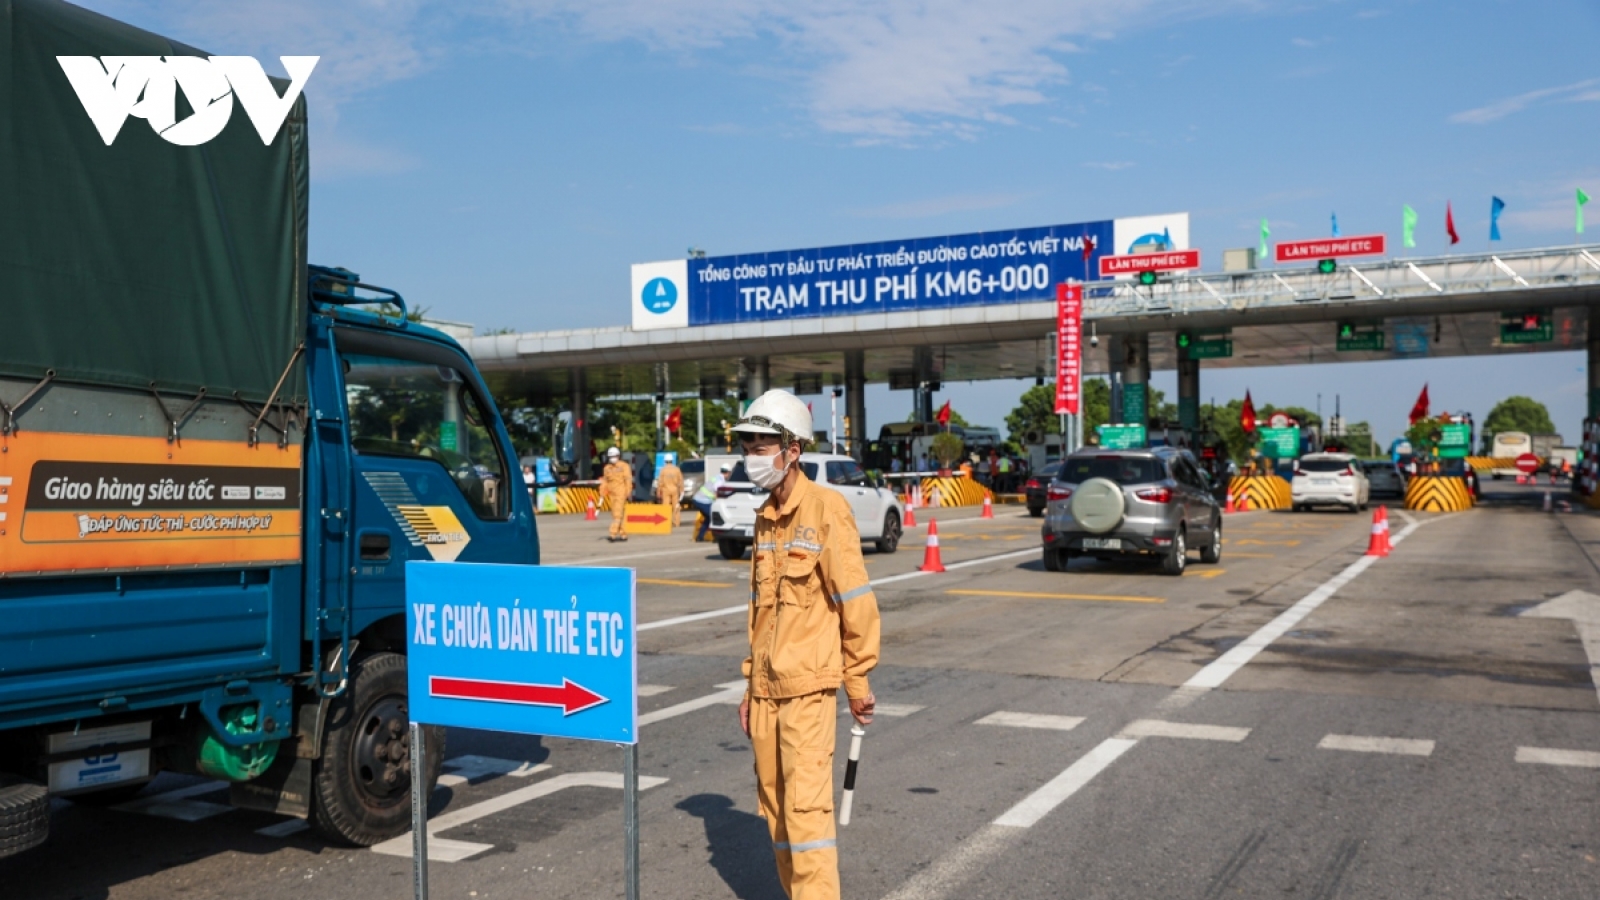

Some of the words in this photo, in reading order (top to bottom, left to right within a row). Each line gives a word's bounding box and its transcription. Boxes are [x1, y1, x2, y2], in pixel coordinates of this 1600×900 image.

[698, 263, 731, 283] TỔNG
[733, 264, 767, 281] CÔNG
[769, 263, 785, 277] TY
[787, 256, 814, 276] ĐẦU
[816, 258, 834, 273] TƯ
[837, 252, 873, 272] PHÁT
[875, 246, 915, 268] TRIỂN
[917, 243, 968, 265] ĐƯỜNG
[1027, 235, 1061, 257] VIỆT
[1108, 256, 1130, 270] LÀN
[1131, 257, 1150, 268] THU
[1151, 253, 1168, 267] PHÍ
[1168, 254, 1188, 265] ETC
[1284, 244, 1308, 257] LÀN
[1309, 243, 1330, 254] THU
[1331, 240, 1349, 253] PHÍ
[1350, 240, 1372, 252] ETC
[740, 283, 809, 314] TRẠM
[815, 279, 867, 307] THU
[875, 266, 918, 302] PHÍ
[924, 263, 1050, 299] KM6+000
[44, 476, 93, 500] Giao
[96, 476, 145, 506] hàng
[147, 478, 185, 500] siêu
[187, 477, 215, 501] tốc
[89, 515, 113, 532] ĐÁP
[114, 515, 140, 532] ỨNG
[142, 514, 165, 531] TỨC
[165, 514, 185, 531] THÌ
[220, 514, 240, 530] PHÍ
[239, 514, 260, 533] HỢP
[260, 514, 272, 530] LÝ
[413, 602, 437, 646] XE
[442, 601, 492, 650] CHƯA
[497, 598, 538, 652] DÁN
[543, 594, 580, 655] THẺ
[586, 611, 624, 658] ETC
